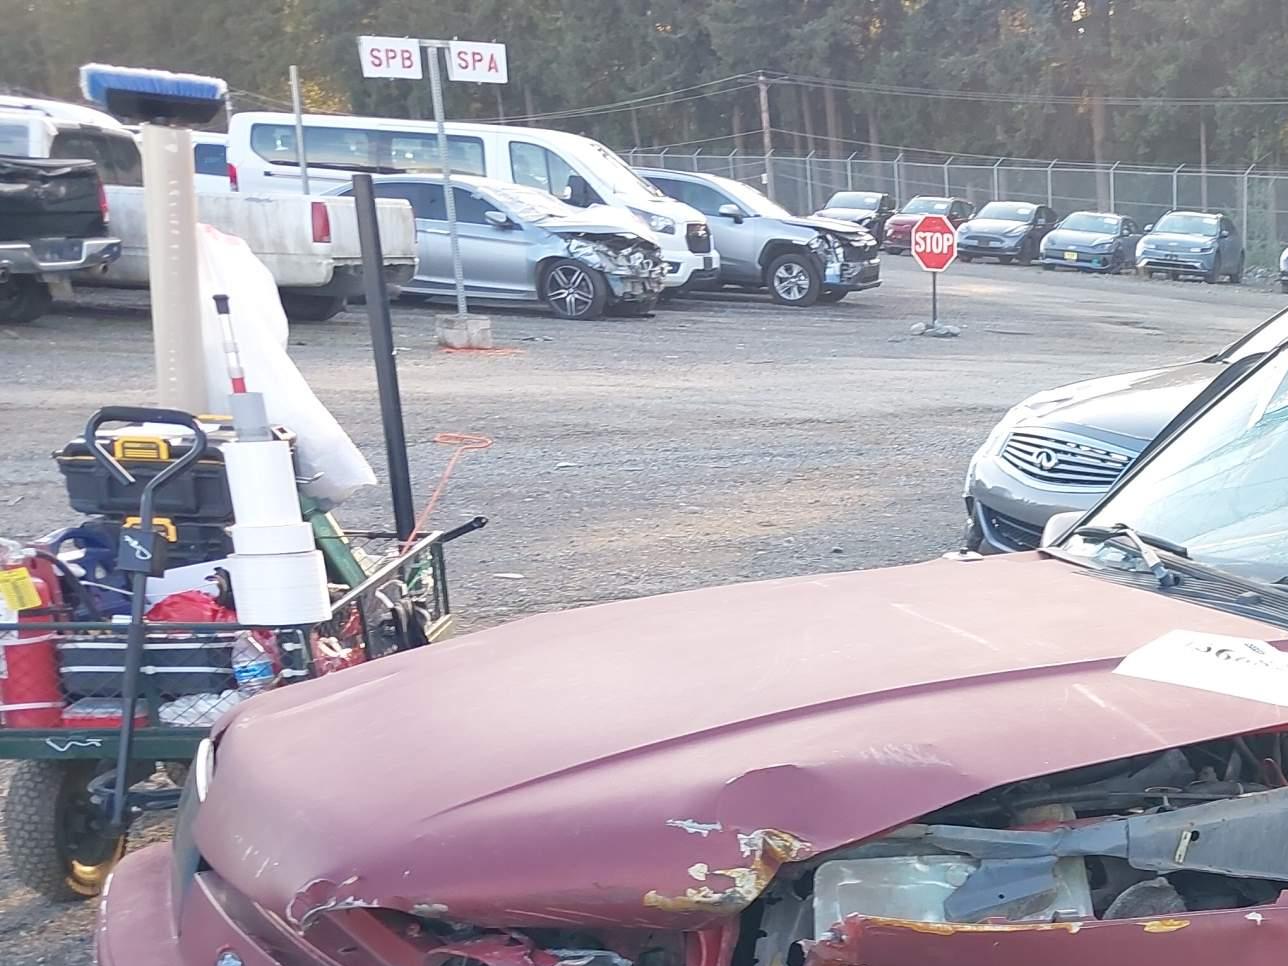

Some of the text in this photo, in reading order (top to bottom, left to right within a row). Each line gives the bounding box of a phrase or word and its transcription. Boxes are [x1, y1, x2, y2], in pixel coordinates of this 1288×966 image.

[369, 47, 414, 69] SPB
[456, 50, 499, 73] SPA
[915, 231, 954, 254] STOP
